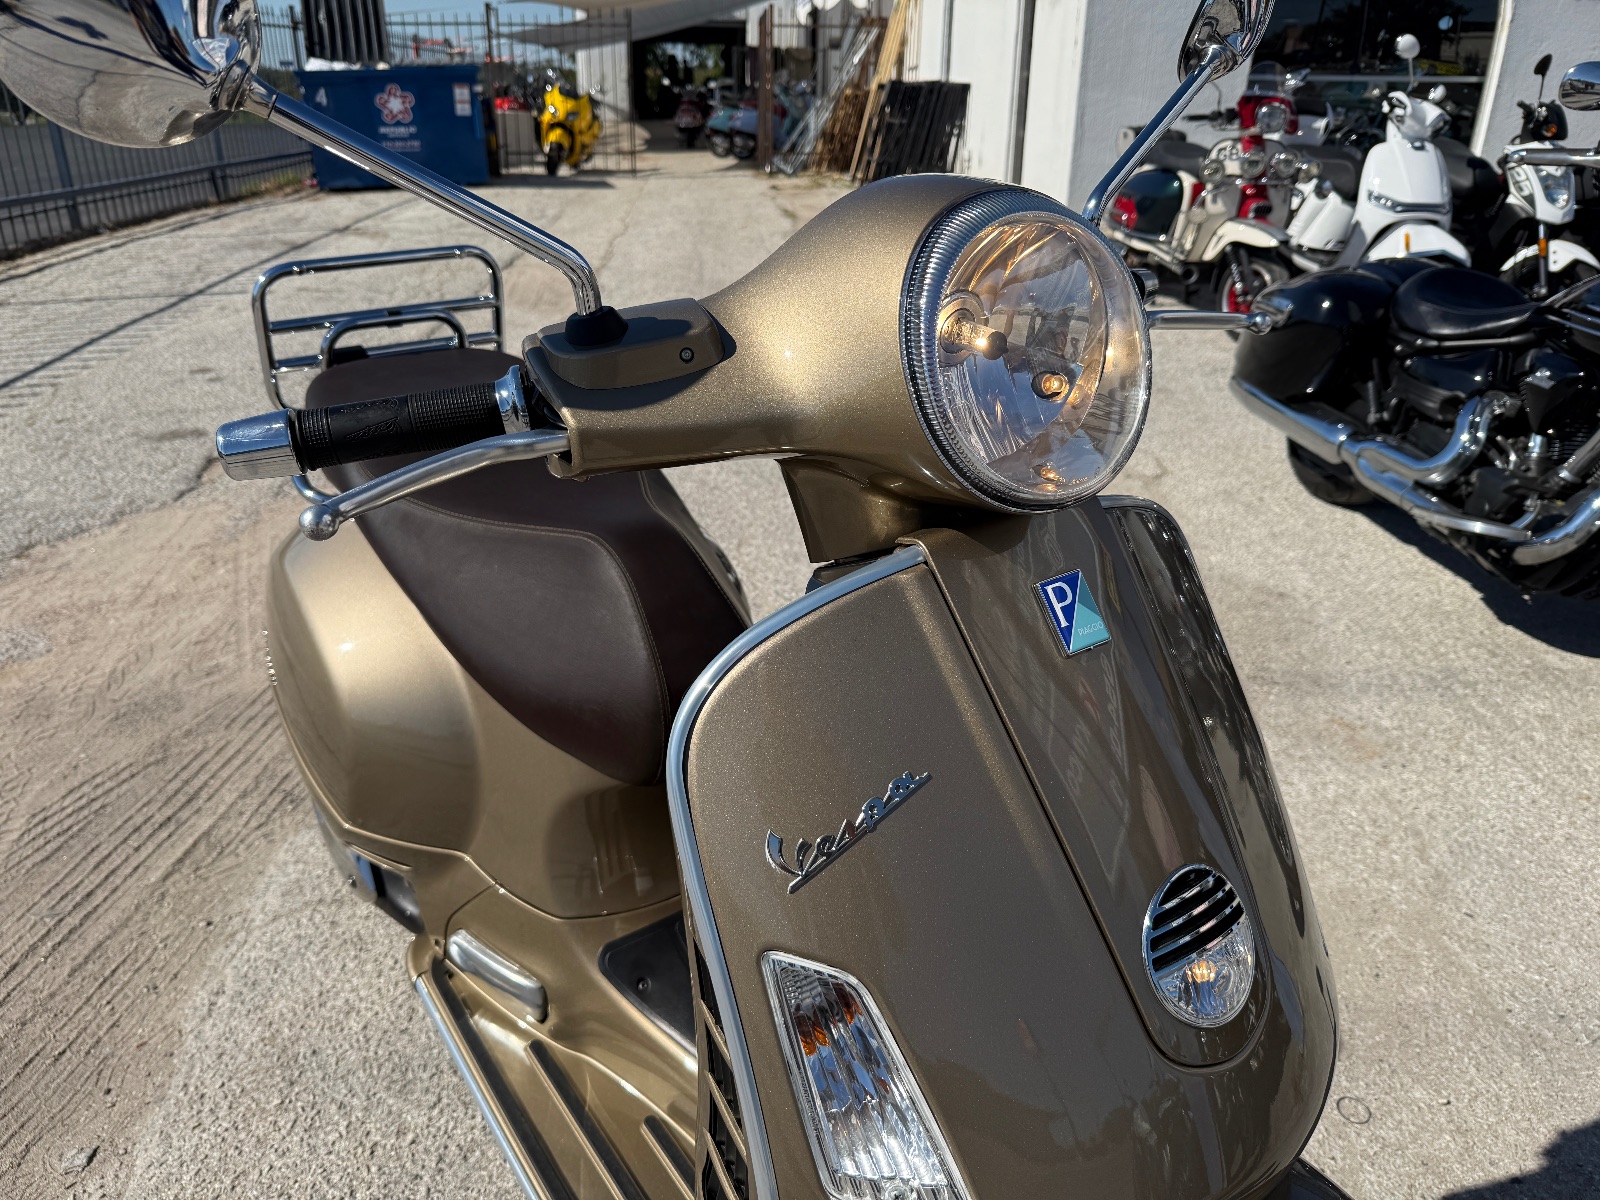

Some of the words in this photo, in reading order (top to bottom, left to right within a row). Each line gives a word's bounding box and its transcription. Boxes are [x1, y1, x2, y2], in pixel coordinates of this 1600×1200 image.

[1044, 581, 1073, 628] P
[1077, 620, 1104, 636] PIAGGIO
[765, 771, 931, 894] Vespa
